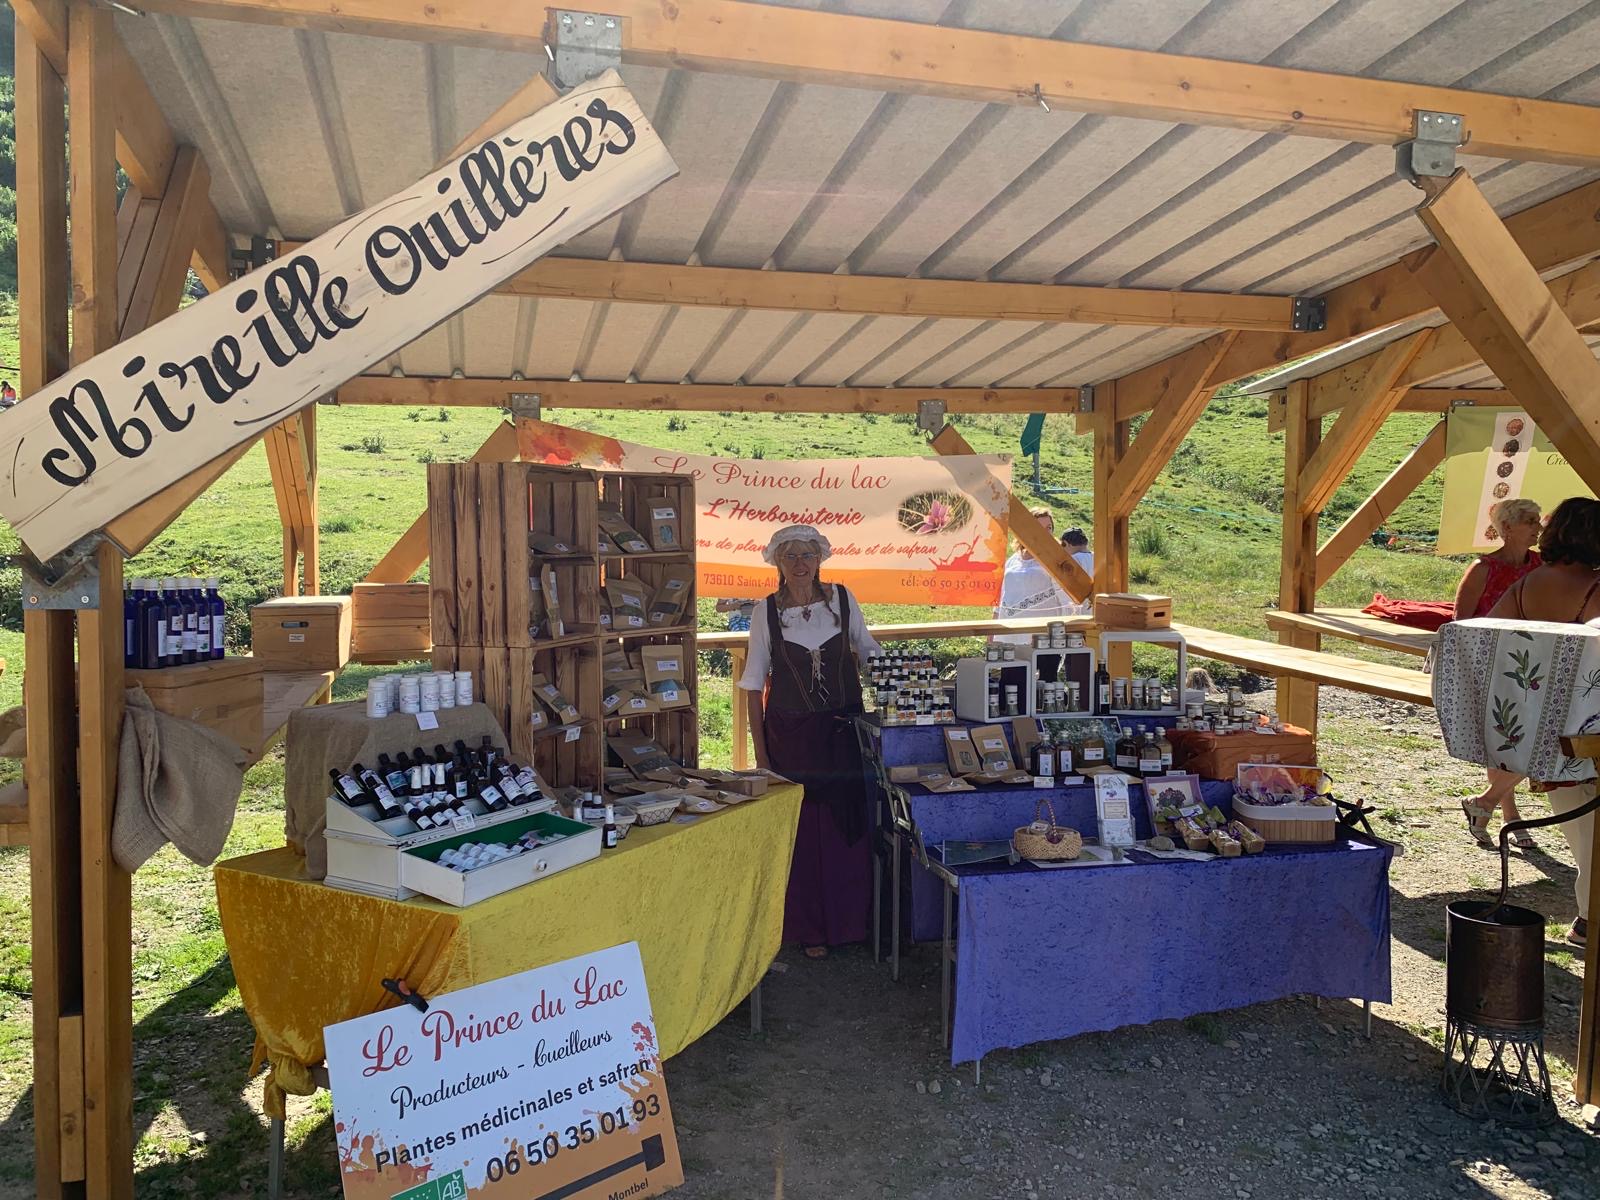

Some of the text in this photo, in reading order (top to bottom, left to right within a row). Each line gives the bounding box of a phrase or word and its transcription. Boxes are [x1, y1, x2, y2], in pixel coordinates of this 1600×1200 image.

[41, 97, 637, 488] Mireille Ouillères
[654, 455, 892, 490] Le Prince du lac
[702, 497, 866, 526] L'Herboristerie
[716, 537, 734, 550] de
[865, 543, 881, 555] et
[880, 542, 896, 555] de
[896, 541, 939, 560] safran
[703, 573, 734, 586] 73610
[922, 576, 937, 588] 06
[940, 579, 953, 590] 50
[955, 579, 965, 590] 35
[969, 580, 981, 589] 01
[984, 580, 998, 591] 93
[362, 965, 628, 1078] Le Prince du Lac
[390, 1065, 510, 1120] Producteurs
[532, 1029, 613, 1069] Cueilleurs
[376, 1059, 650, 1173] Plantes médicinales et safran
[486, 1093, 661, 1183] 06 50 35 01 93
[608, 1177, 649, 1200] Montbel
